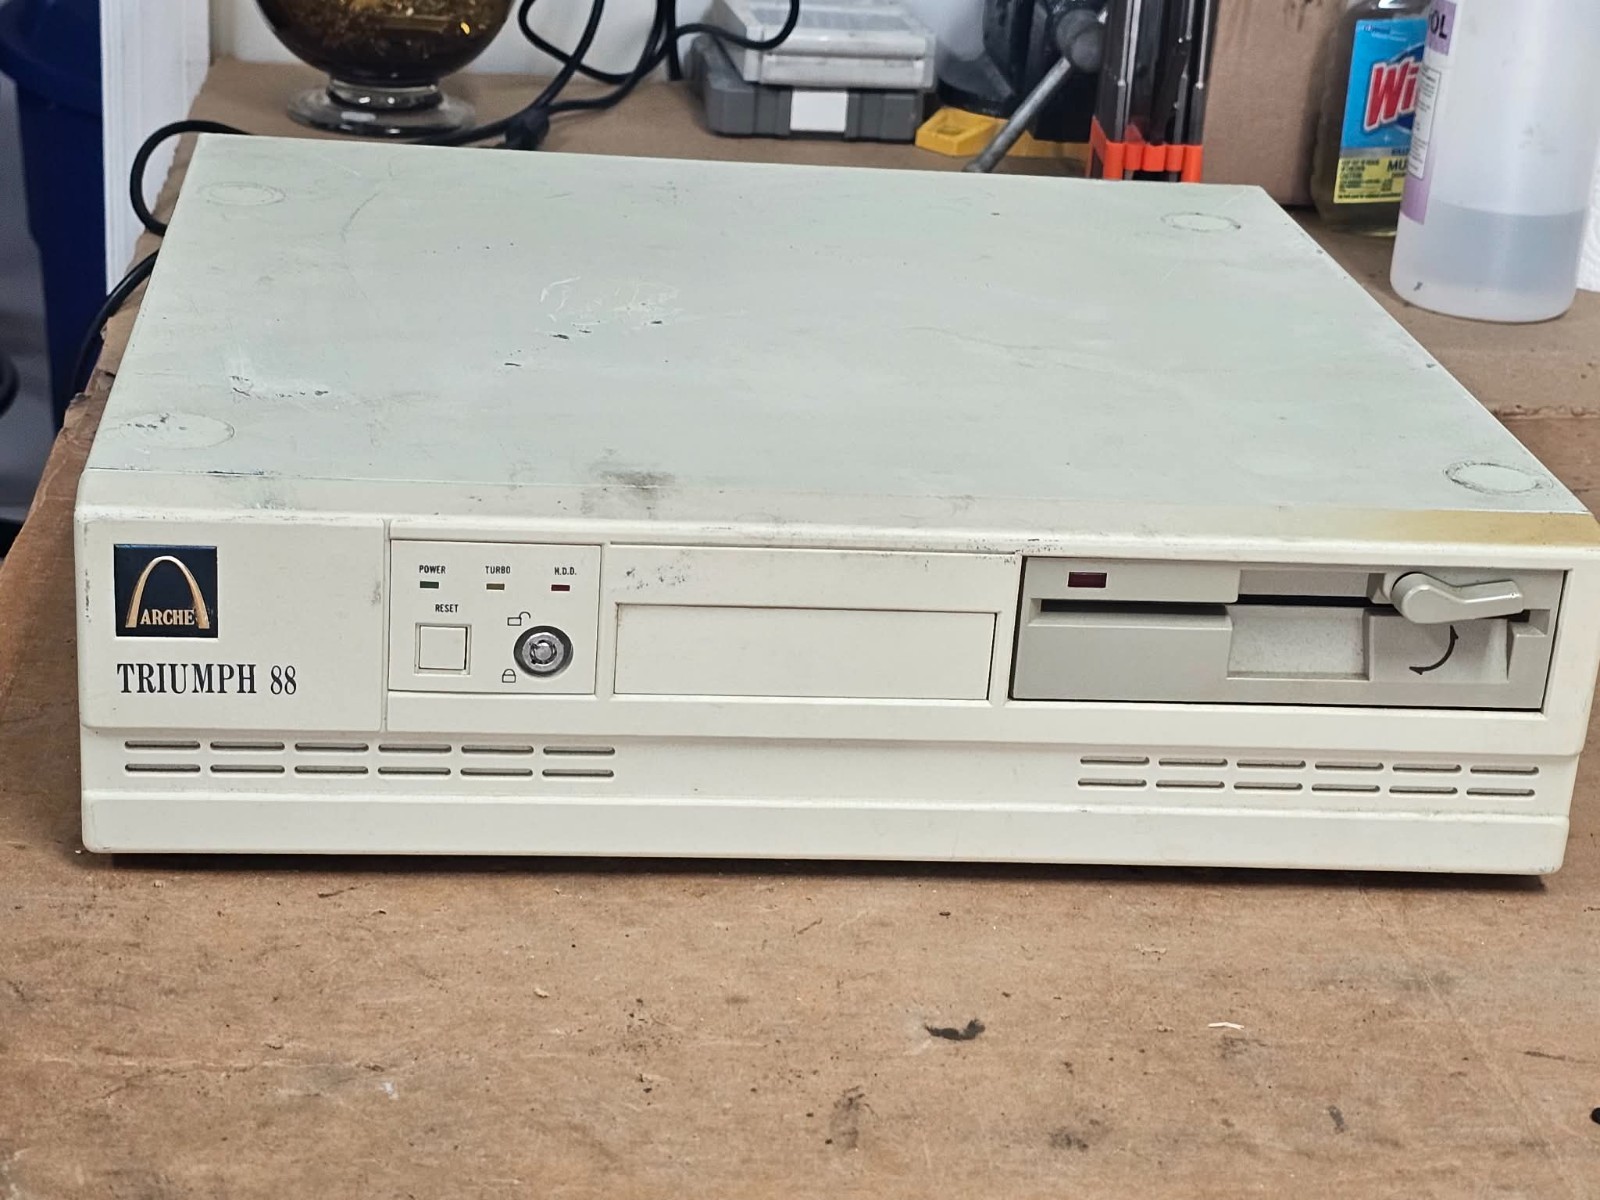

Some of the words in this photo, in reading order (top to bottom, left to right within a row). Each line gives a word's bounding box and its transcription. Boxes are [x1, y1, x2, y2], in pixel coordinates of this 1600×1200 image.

[418, 564, 446, 575] POWER
[485, 565, 511, 575] TURBO
[554, 566, 577, 576] H.D.D.
[435, 603, 459, 613] RESET
[140, 608, 195, 626] ARCHE
[116, 663, 257, 695] TRIUMPH
[270, 665, 297, 695] 88
